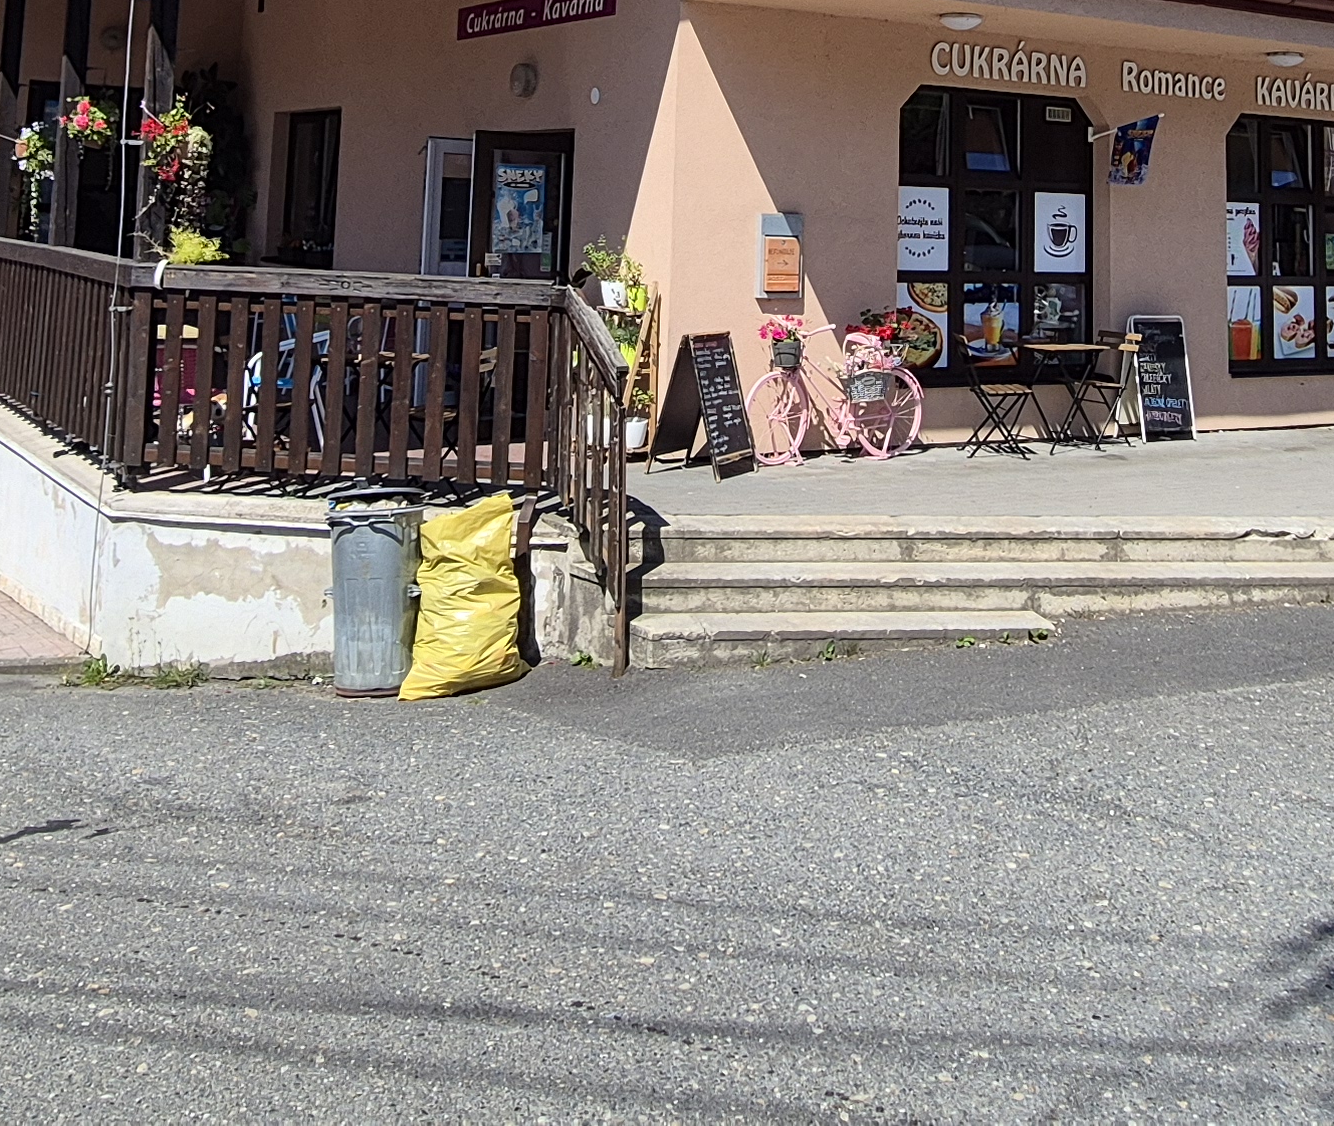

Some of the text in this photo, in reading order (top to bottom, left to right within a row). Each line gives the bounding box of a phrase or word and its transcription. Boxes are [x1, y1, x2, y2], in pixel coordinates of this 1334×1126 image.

[466, 7, 524, 33] Cukrárna
[931, 40, 1087, 87] CUKRÁRNA
[1121, 61, 1226, 101] Romance
